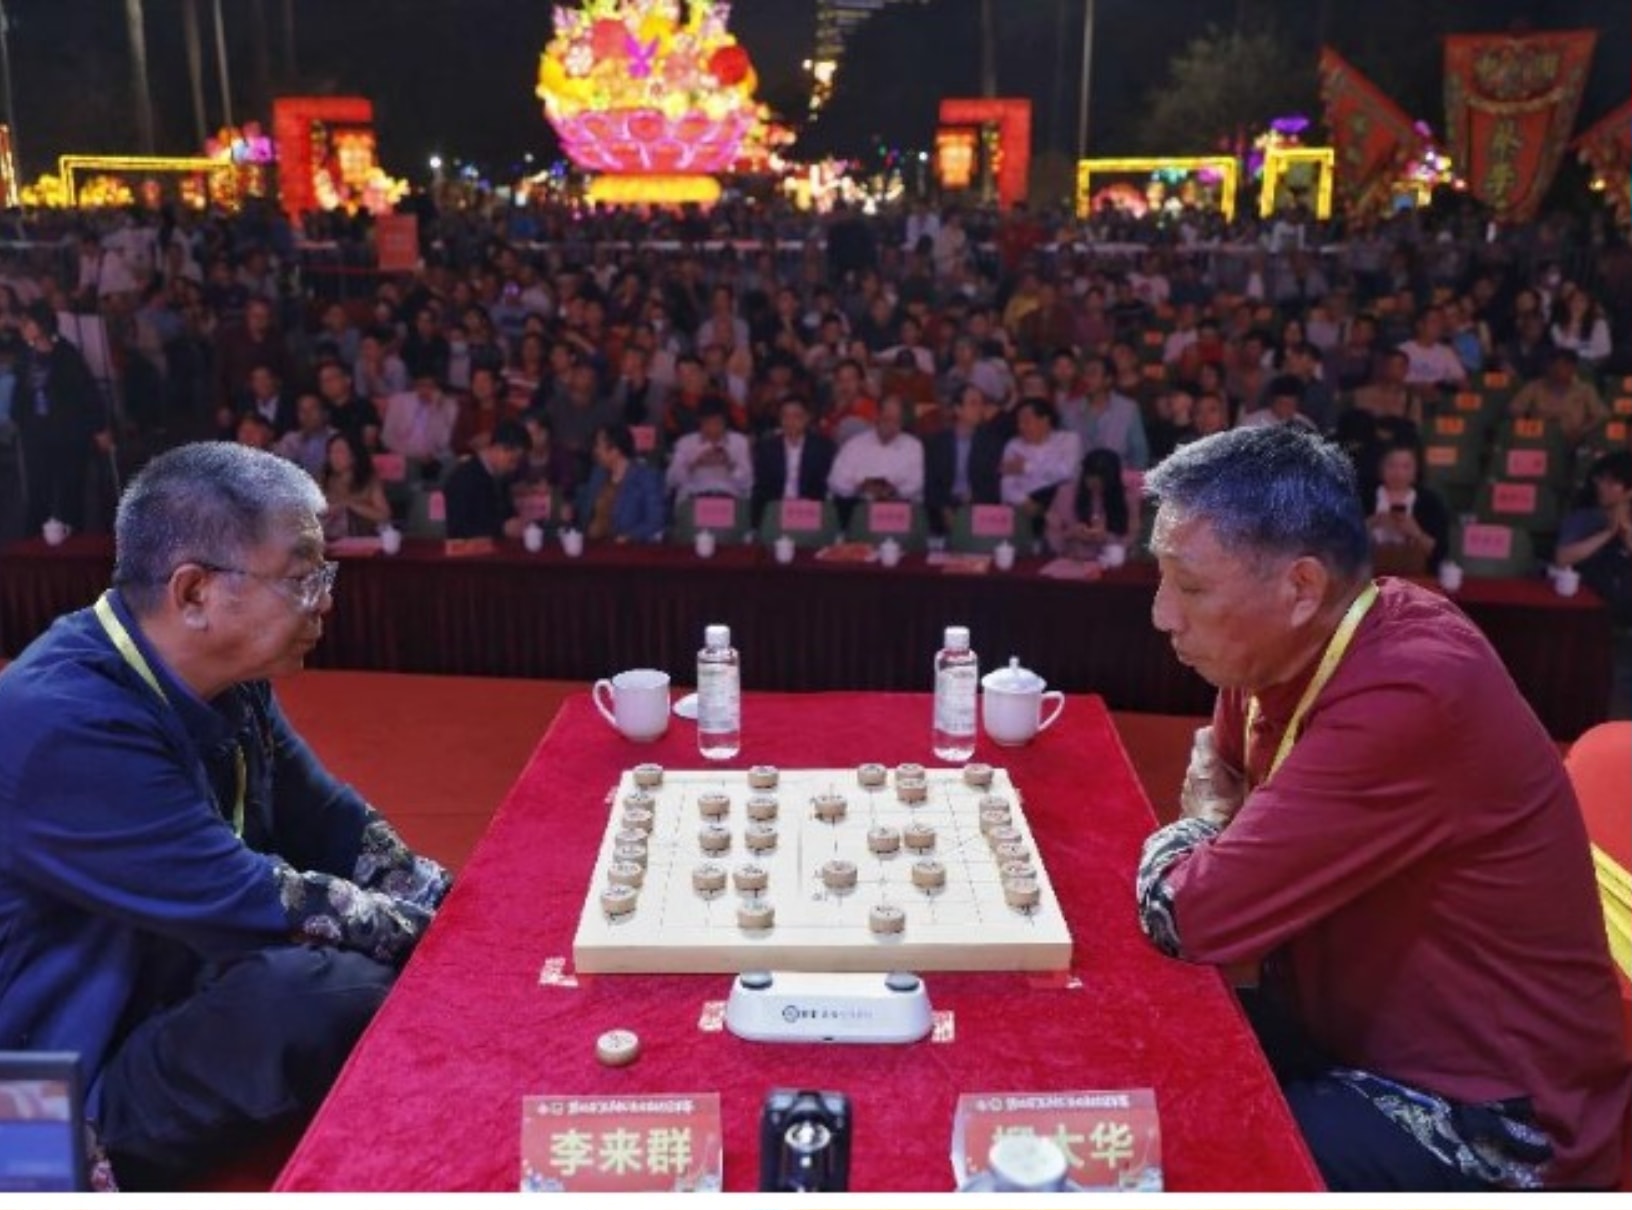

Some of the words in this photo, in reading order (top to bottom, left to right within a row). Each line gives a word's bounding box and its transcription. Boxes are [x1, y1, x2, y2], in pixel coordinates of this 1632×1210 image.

[550, 1127, 692, 1175] 李来群
[992, 1121, 1133, 1169] 大华
